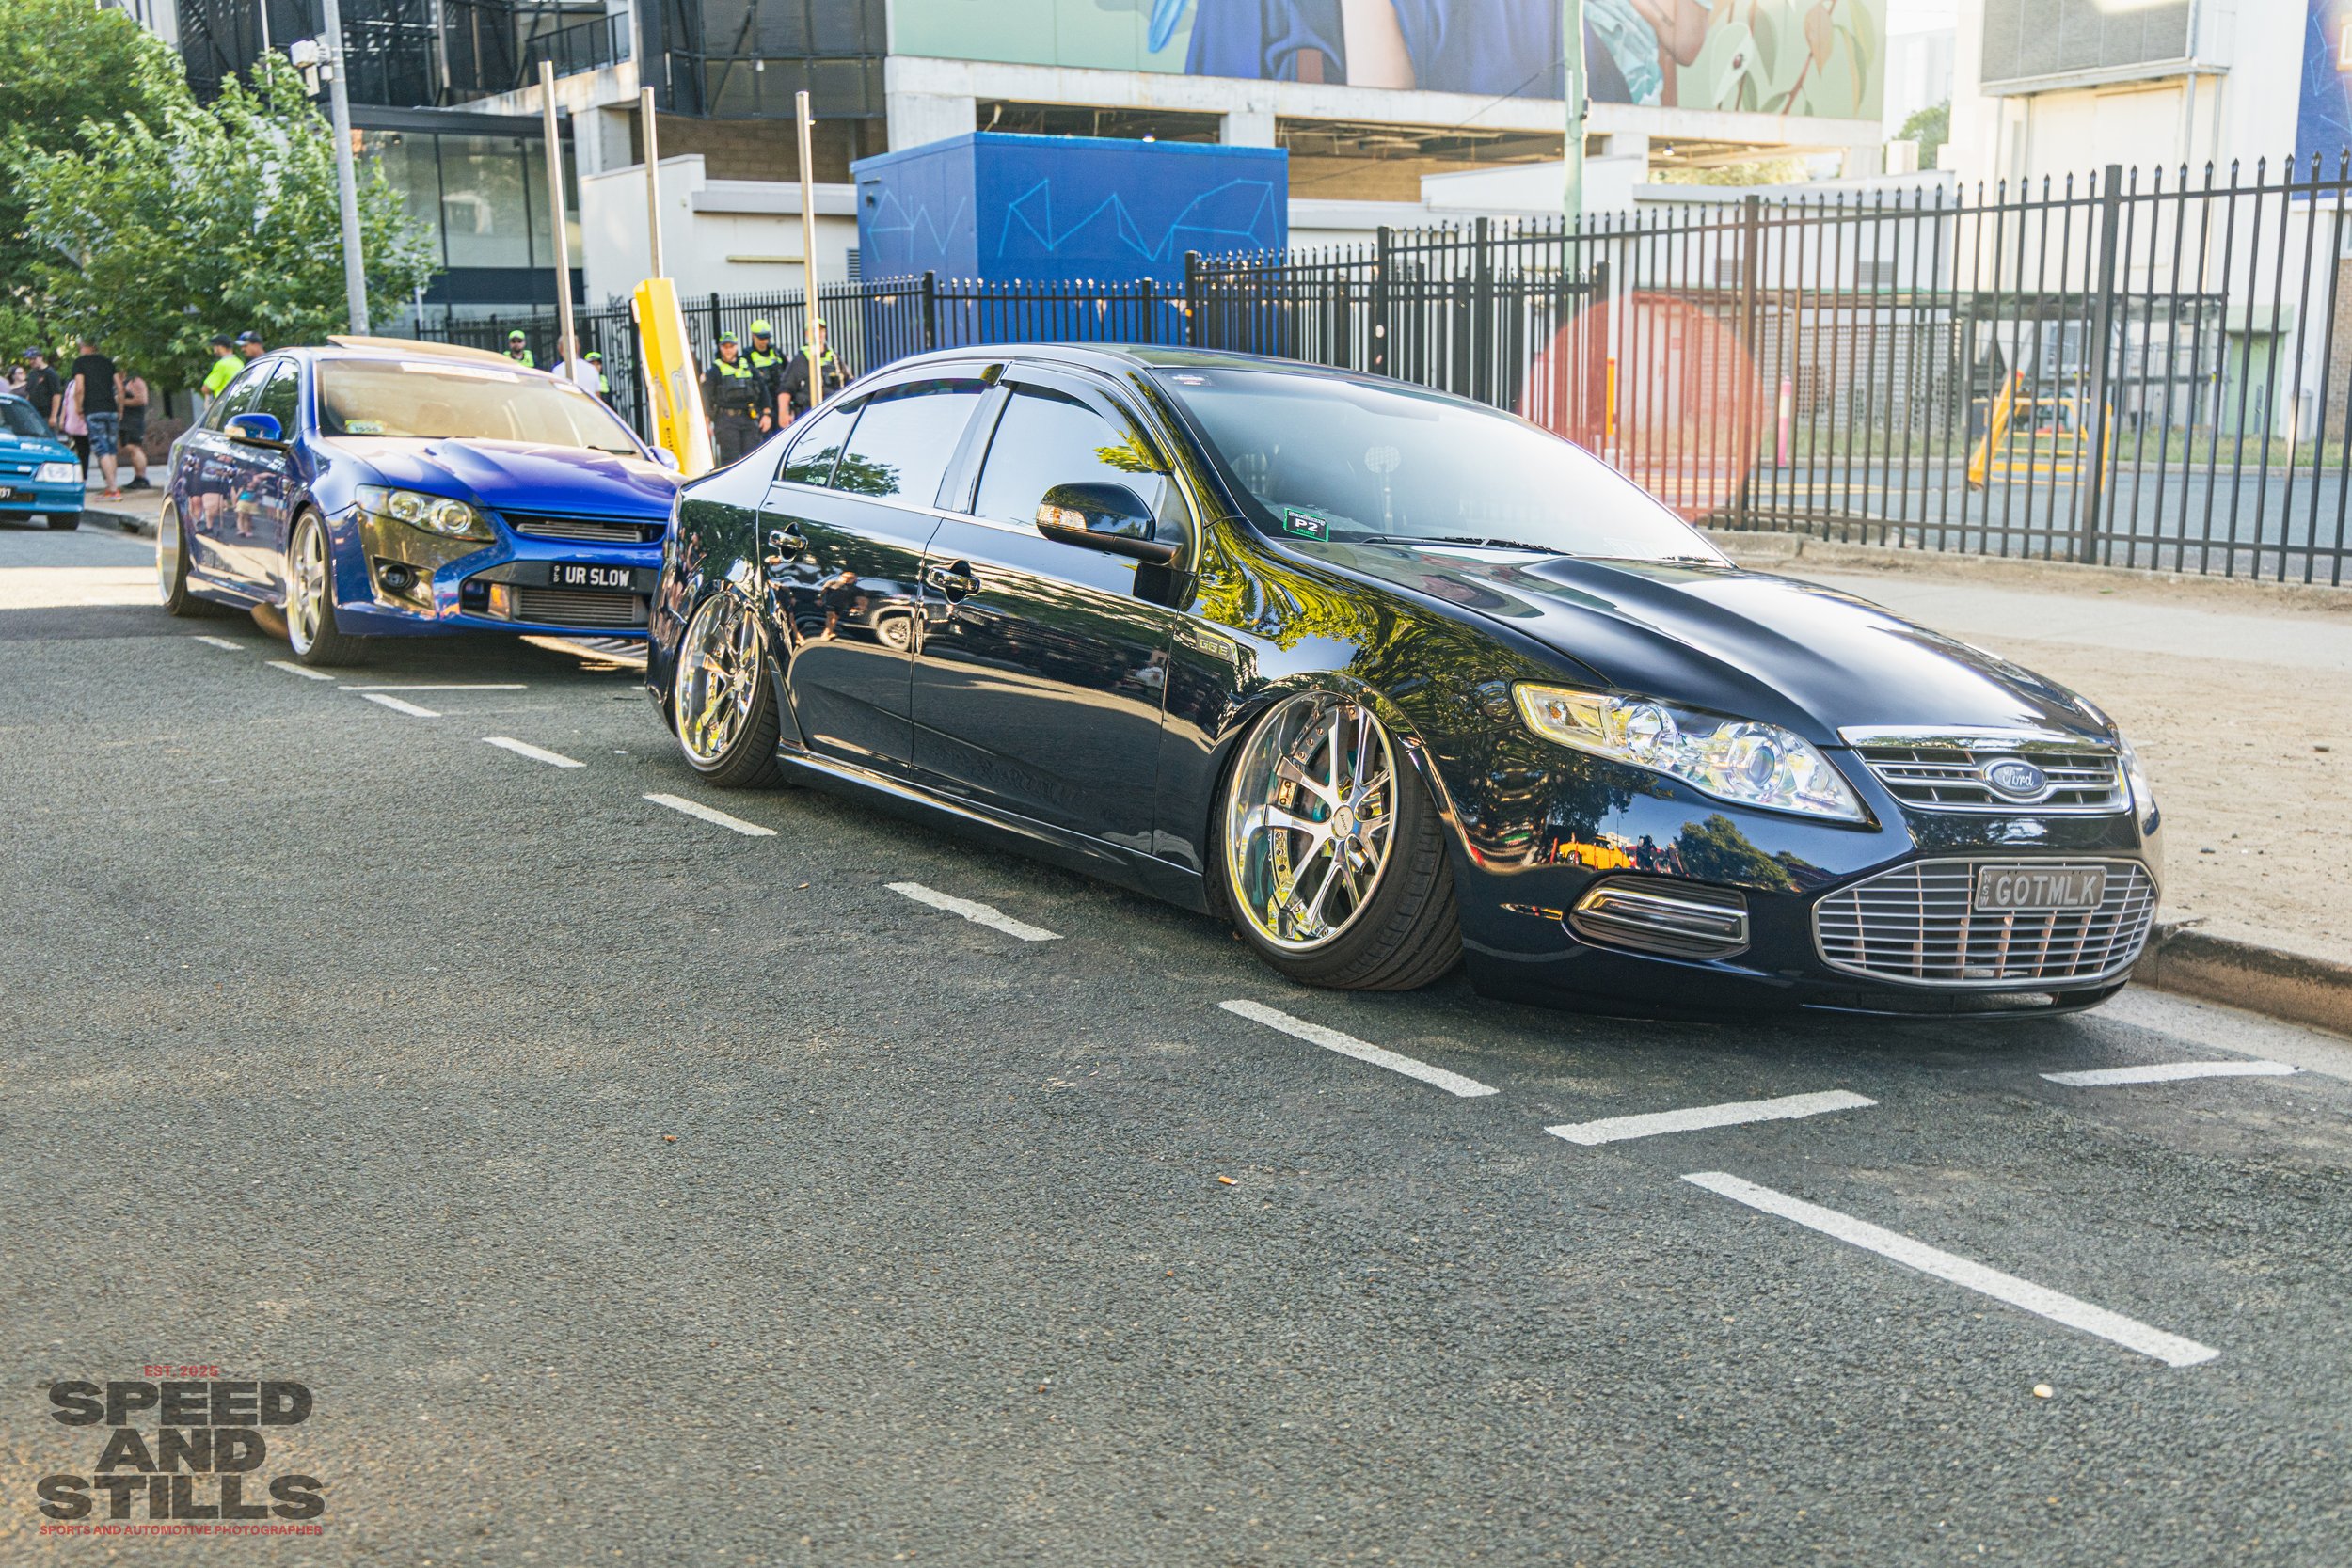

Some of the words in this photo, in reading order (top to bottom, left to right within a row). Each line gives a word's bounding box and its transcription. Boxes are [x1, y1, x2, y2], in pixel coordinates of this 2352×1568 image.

[1295, 518, 1318, 532] P2
[565, 566, 586, 584] UR
[590, 568, 630, 587] SLOW
[2002, 766, 2034, 787] Ford
[1980, 874, 1992, 906] NSW
[1995, 875, 2097, 906] GOTMLK
